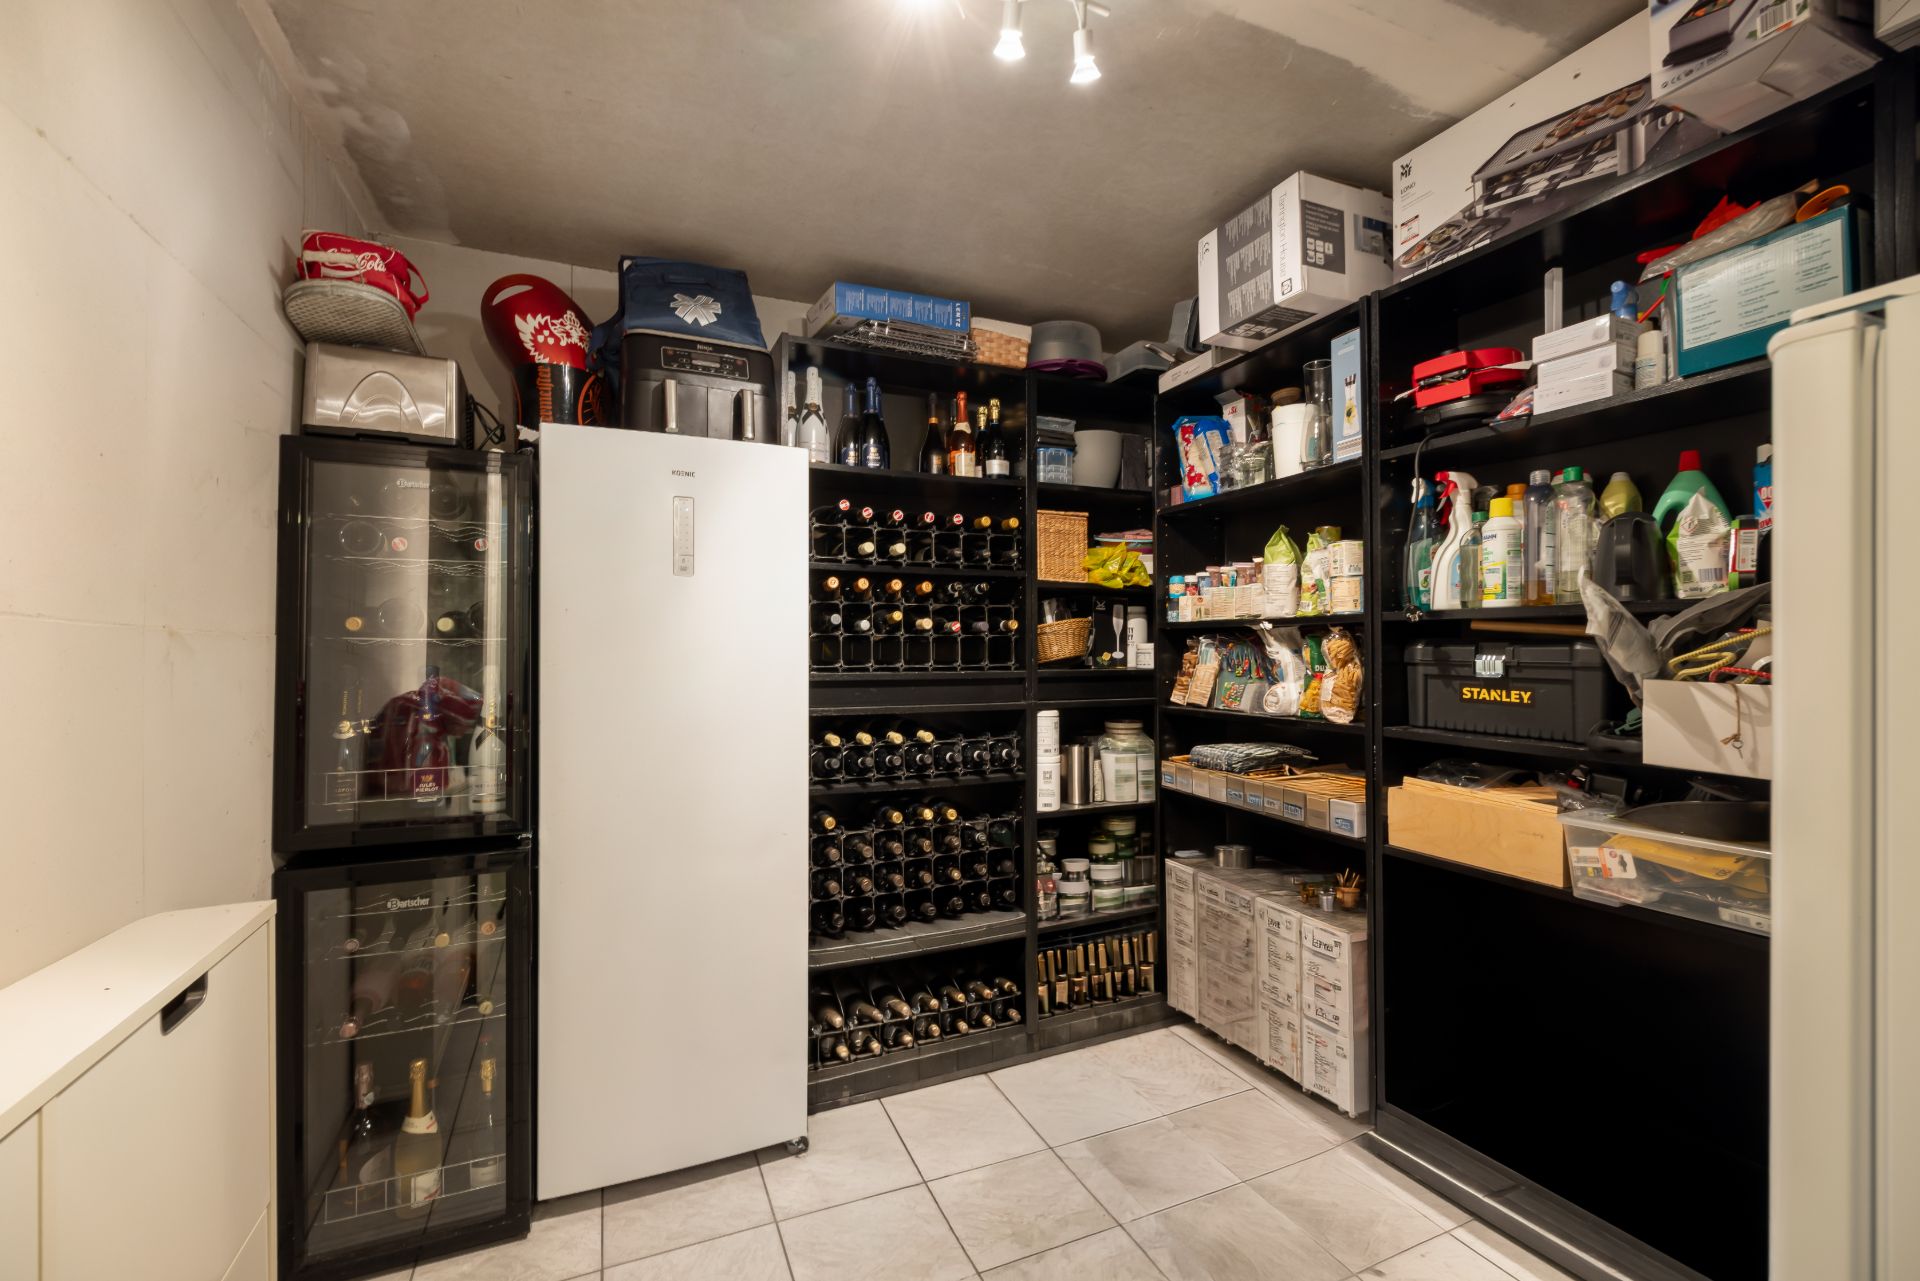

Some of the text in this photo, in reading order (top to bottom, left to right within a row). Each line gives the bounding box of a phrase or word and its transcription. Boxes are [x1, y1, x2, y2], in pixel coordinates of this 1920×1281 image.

[537, 366, 553, 423] ermeister
[671, 470, 696, 478] KOENIC
[1462, 687, 1532, 704] STANLEY
[387, 897, 430, 910] Bartscher
